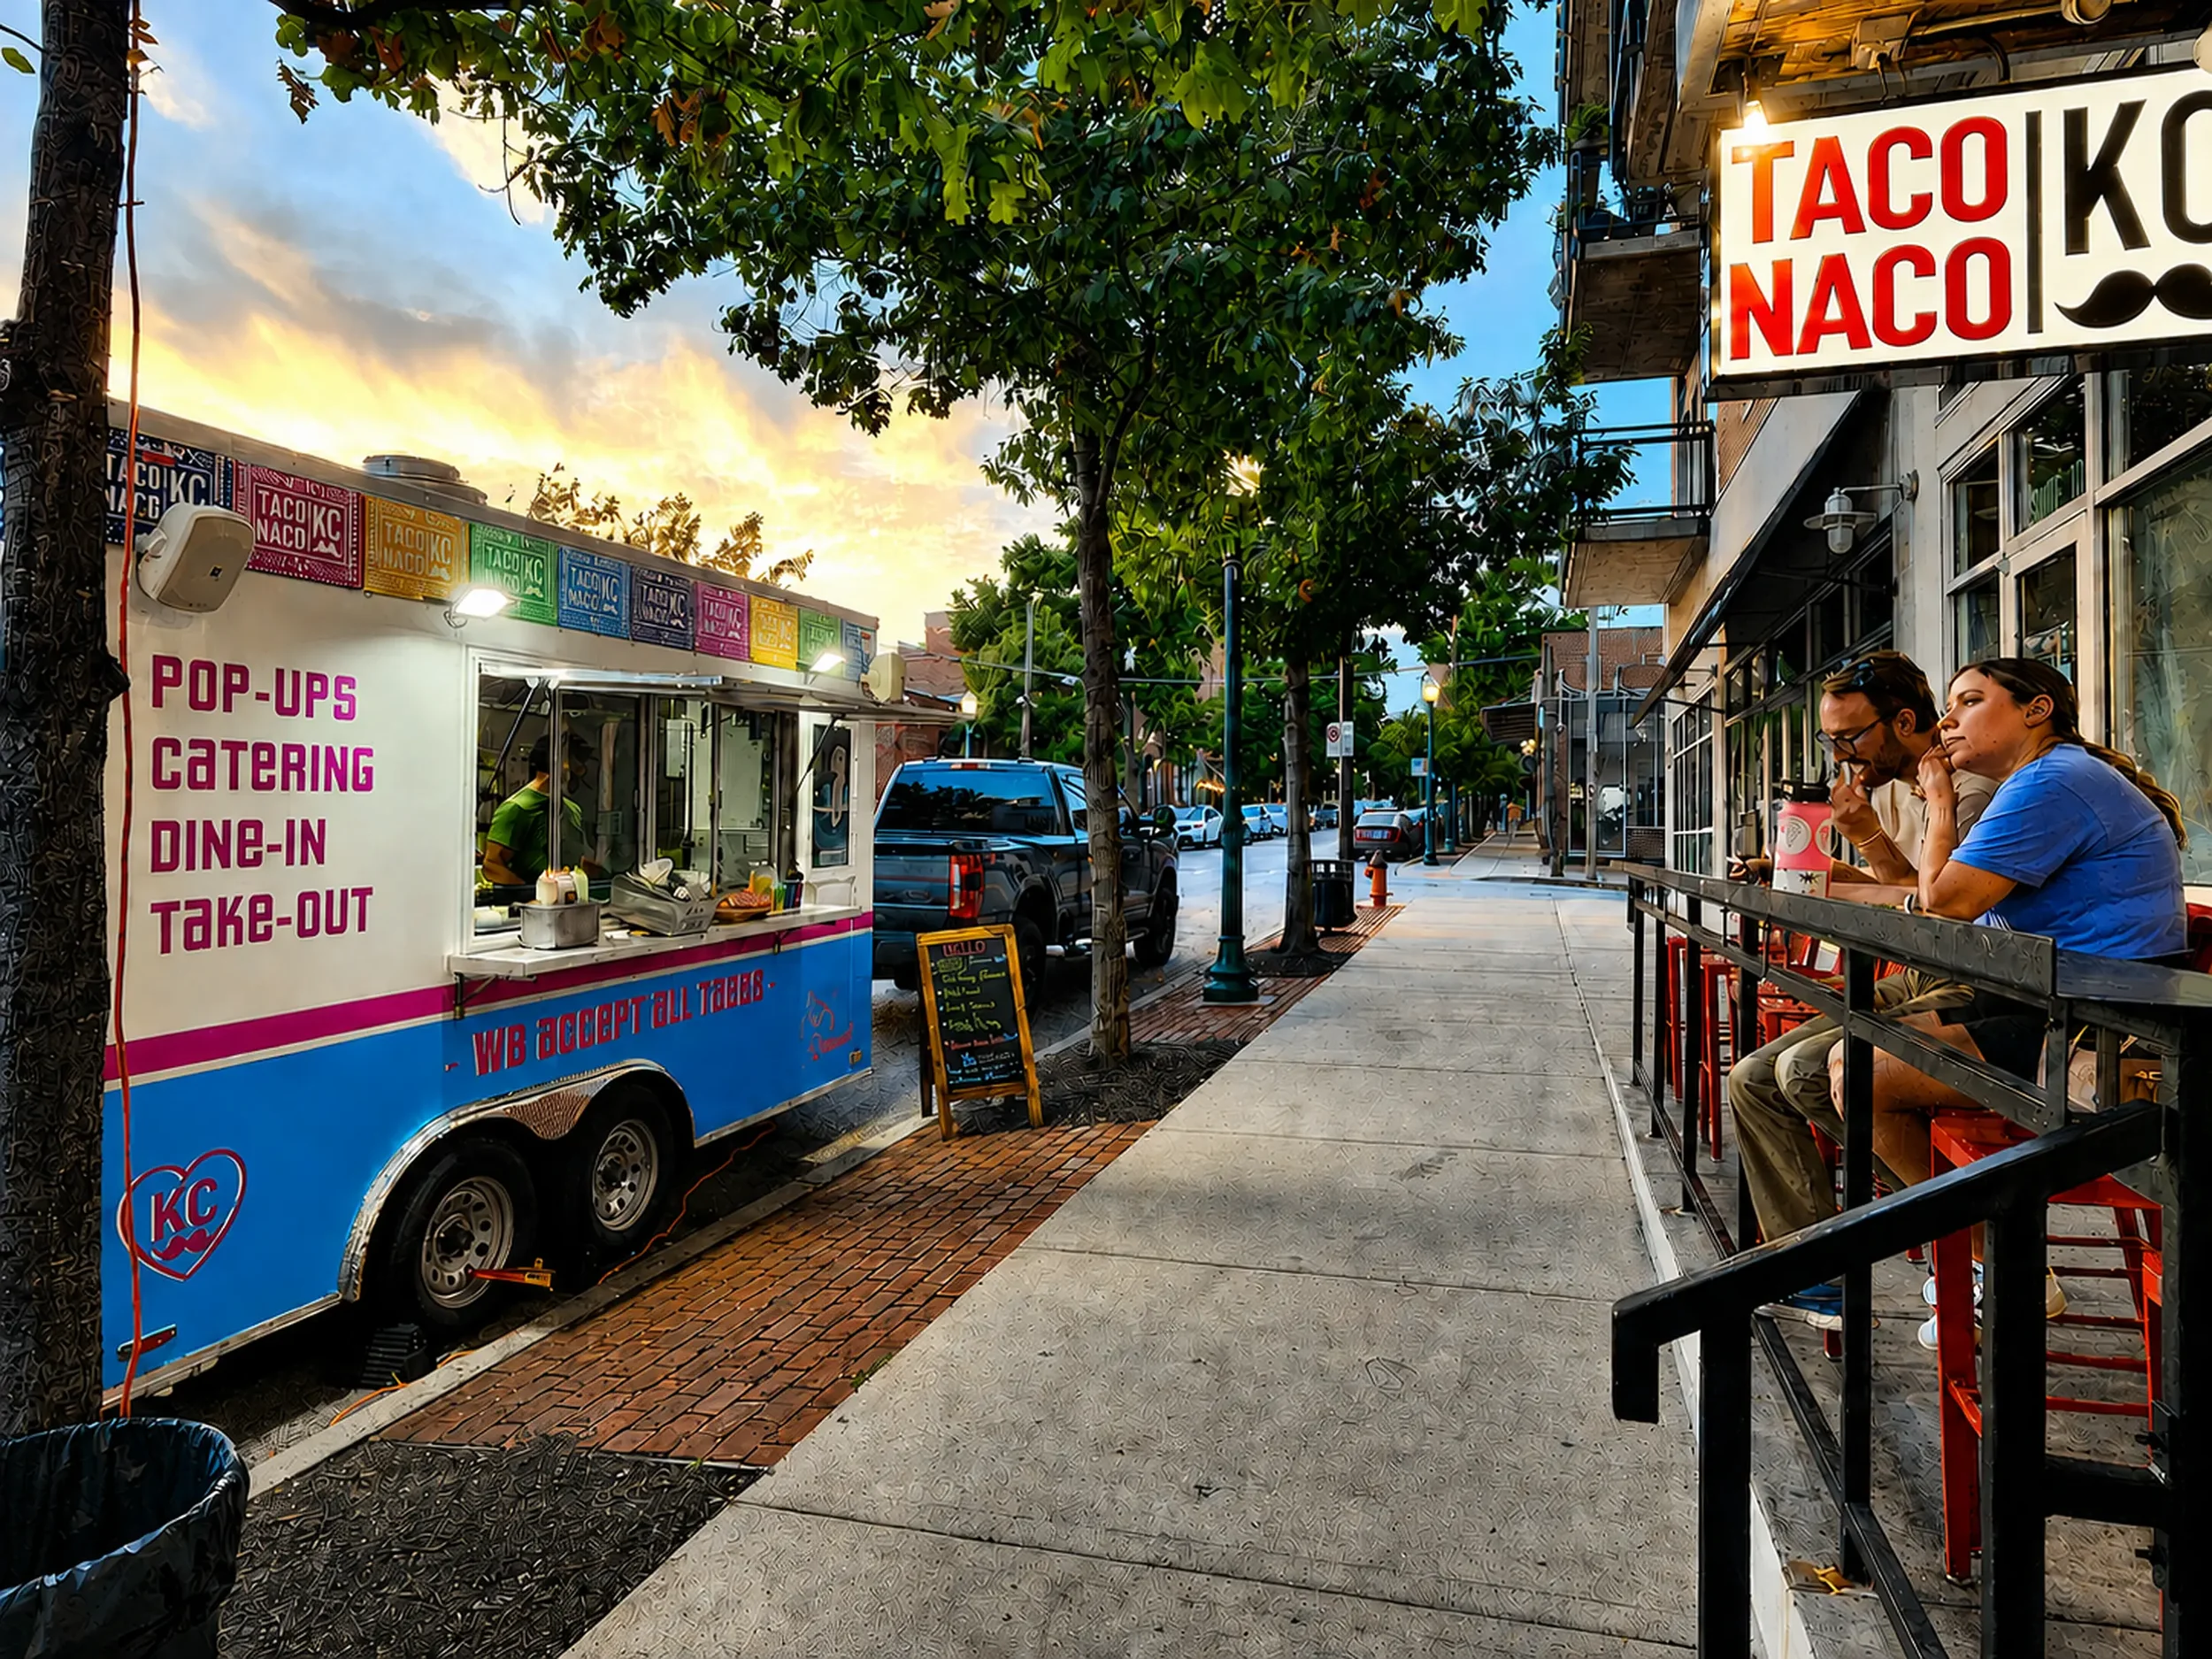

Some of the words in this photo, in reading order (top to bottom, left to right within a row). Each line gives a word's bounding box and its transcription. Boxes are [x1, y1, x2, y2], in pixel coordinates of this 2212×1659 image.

[1731, 116, 2008, 244] TACO
[1730, 236, 2012, 361] NACO
[170, 469, 206, 507] KC
[257, 489, 306, 524] TACO
[312, 504, 341, 541] KC
[256, 518, 305, 550] NACO
[384, 521, 425, 551] TACO
[430, 533, 451, 565] KC
[383, 547, 425, 575] NACO
[487, 545, 520, 572] TACO
[151, 654, 357, 721] POP-UPS
[150, 1178, 218, 1242] KC
